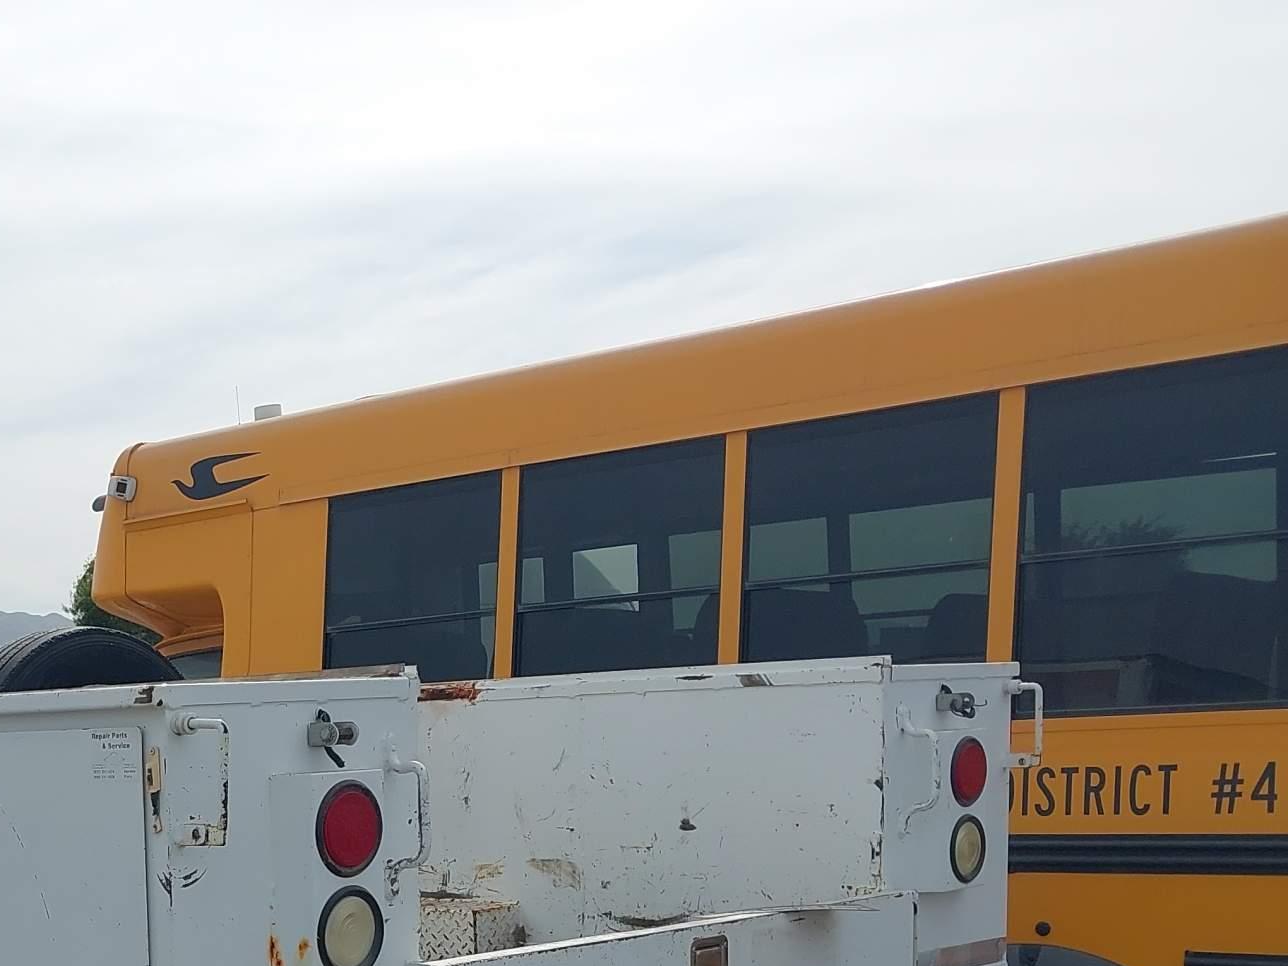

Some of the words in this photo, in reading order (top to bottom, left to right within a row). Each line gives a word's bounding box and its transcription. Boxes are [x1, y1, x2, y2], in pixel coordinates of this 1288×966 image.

[92, 732, 110, 741] Repair
[112, 732, 127, 740] Parts
[108, 742, 130, 750] Service
[1008, 764, 1179, 817] ISTRICT
[1210, 761, 1279, 815] #4
